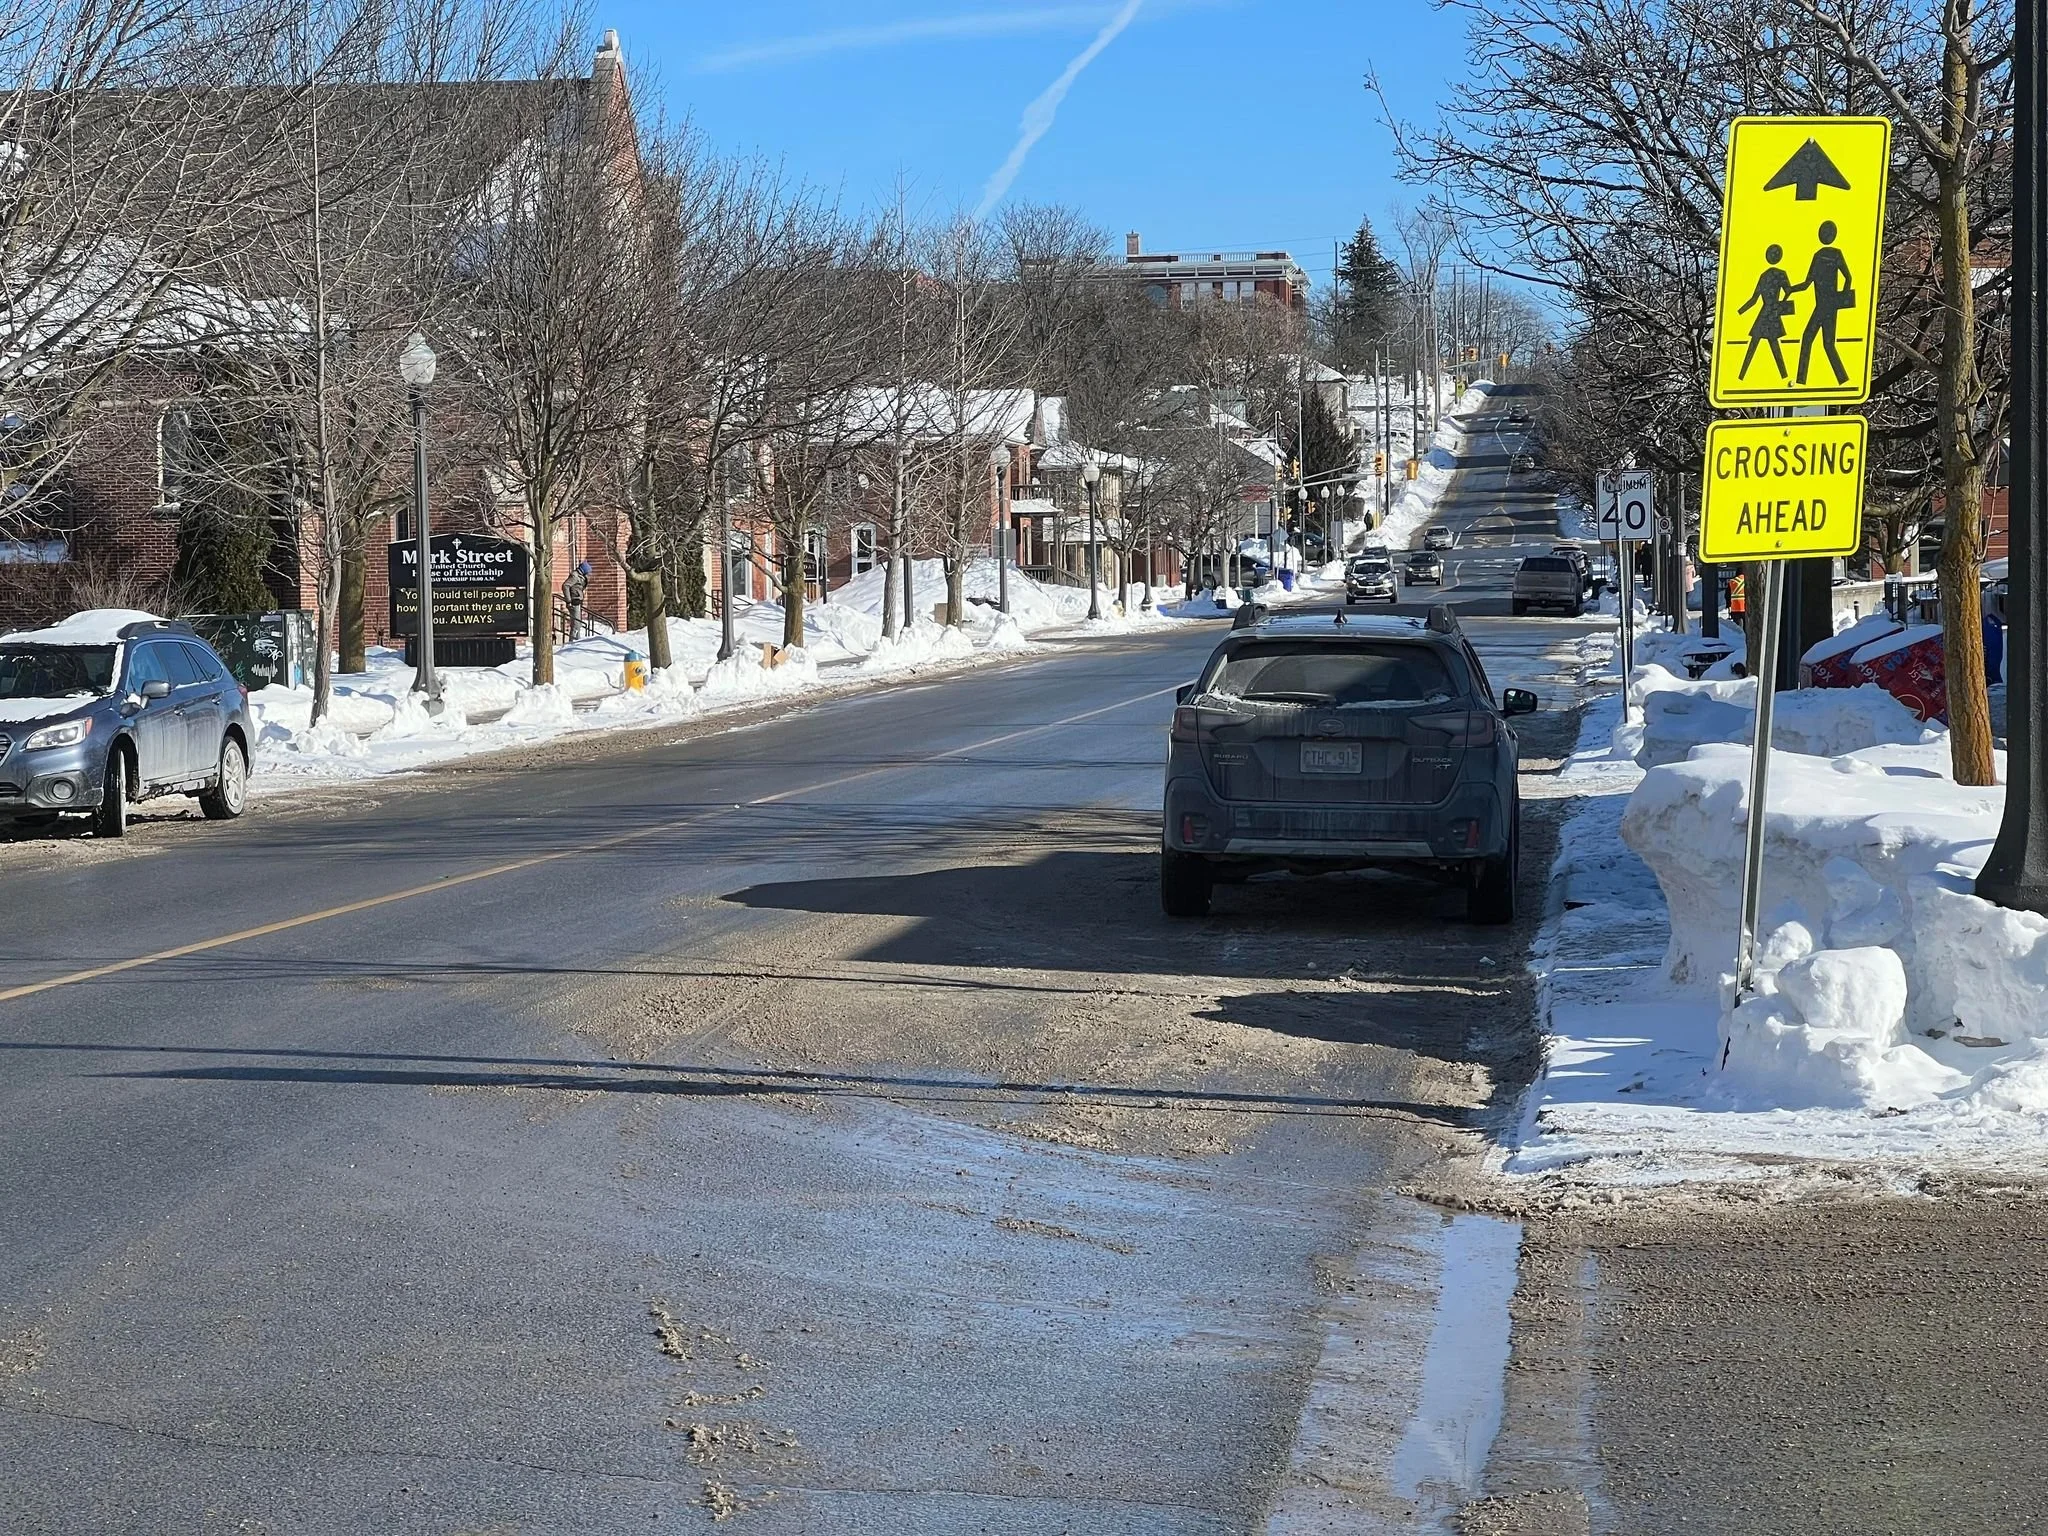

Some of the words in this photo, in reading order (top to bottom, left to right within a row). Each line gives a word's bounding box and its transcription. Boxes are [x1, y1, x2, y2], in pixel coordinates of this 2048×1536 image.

[1716, 441, 1855, 480] CROSSING
[1602, 479, 1647, 490] IMUM
[1601, 500, 1646, 530] 40
[1736, 499, 1827, 535] AHEAD
[402, 550, 451, 564] Mrk
[456, 549, 513, 563] Street
[412, 569, 441, 577] Hse
[455, 568, 504, 577] Friendship
[405, 591, 418, 600] Yo
[433, 590, 460, 599] hould
[463, 590, 478, 599] tell
[481, 589, 515, 600] people
[396, 603, 418, 612] how
[433, 604, 469, 613] portant
[472, 602, 493, 613] they
[495, 603, 512, 611] are
[514, 602, 524, 610] to
[433, 617, 448, 625] ou.
[450, 614, 495, 624] ALWAYS.
